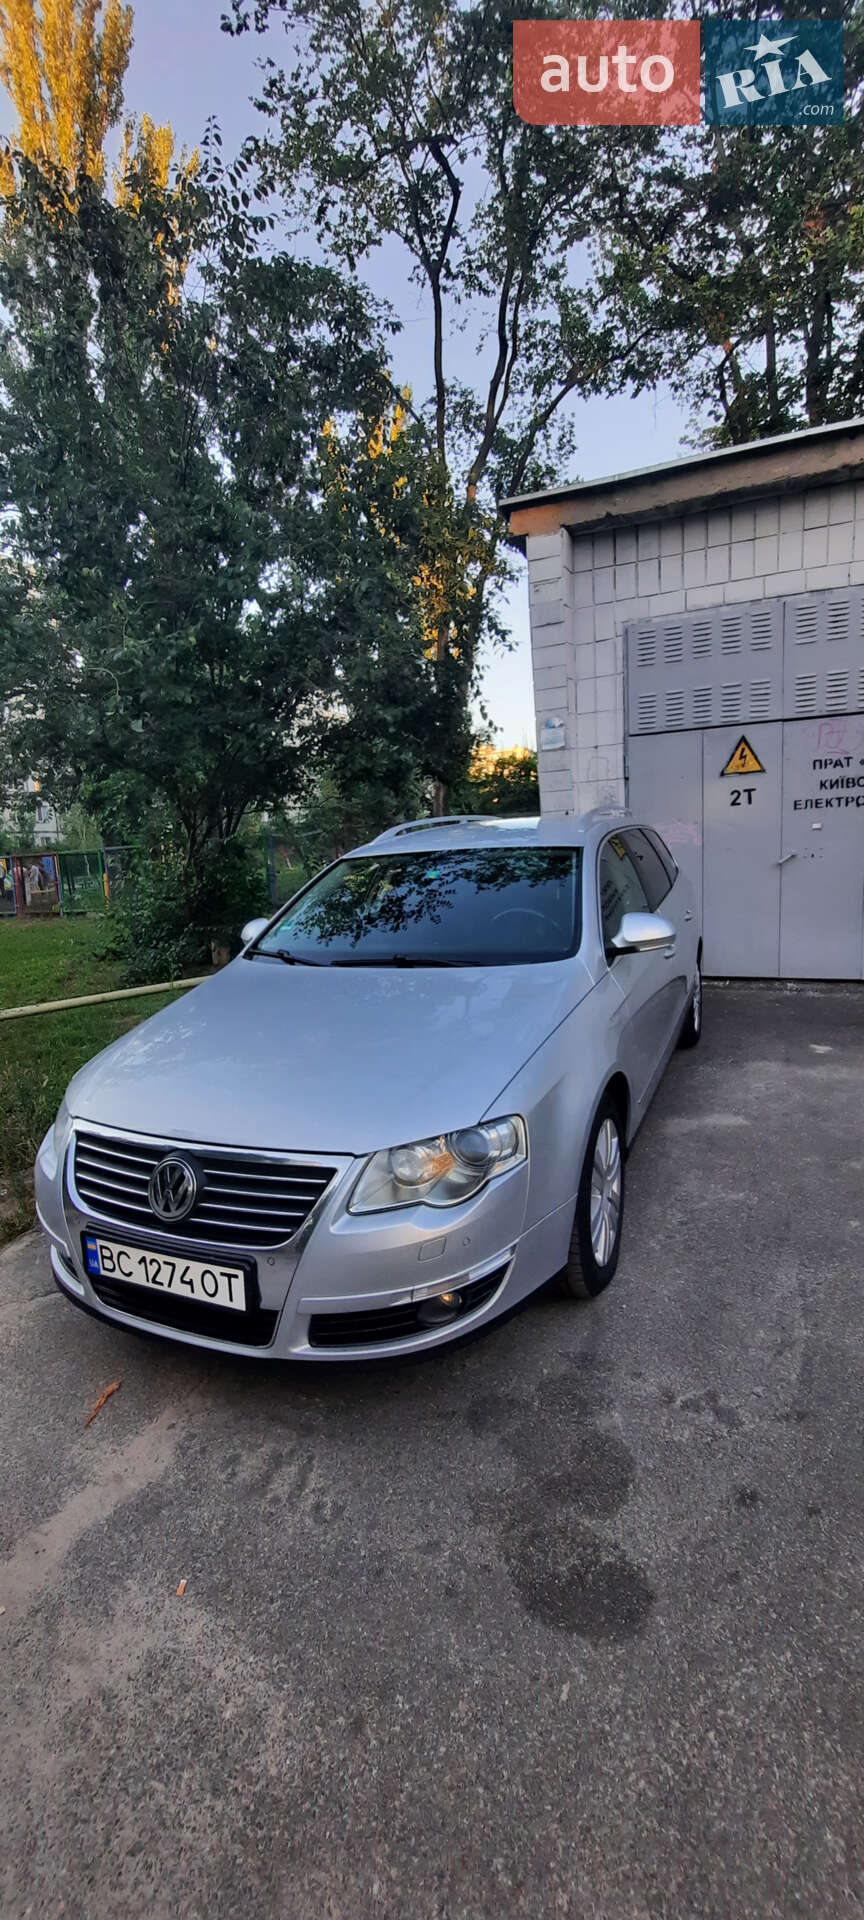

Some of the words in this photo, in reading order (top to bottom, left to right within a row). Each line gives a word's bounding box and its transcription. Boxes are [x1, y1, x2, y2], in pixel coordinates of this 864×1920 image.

[813, 756, 853, 770] ПРАТ
[99, 1244, 133, 1277] BC
[138, 1255, 195, 1294] 1274
[200, 1269, 239, 1302] OT
